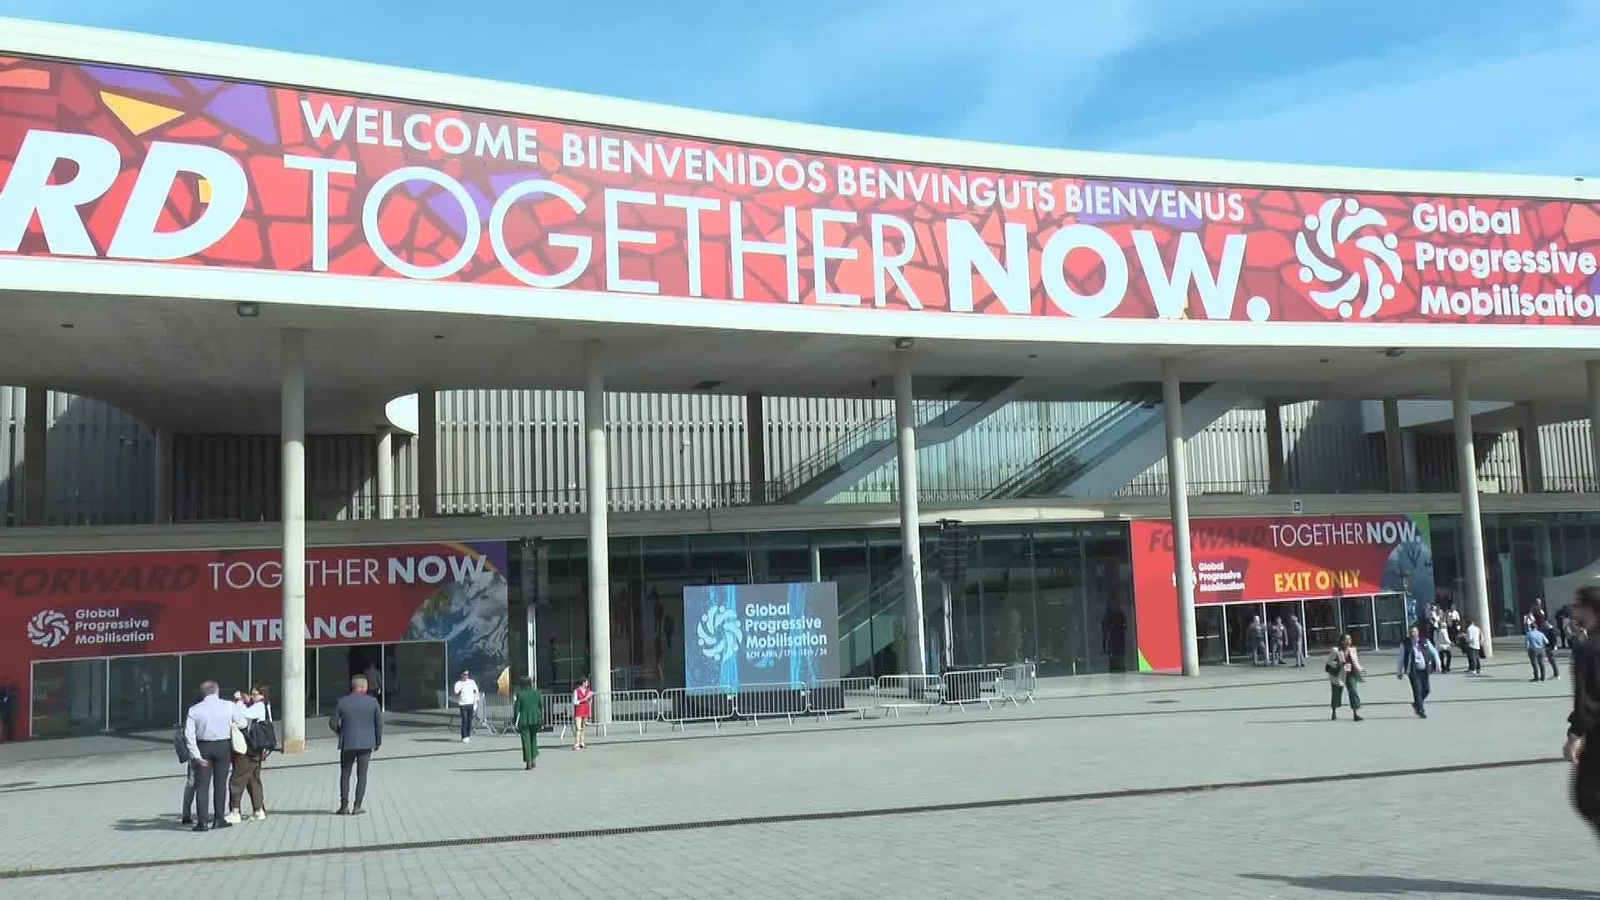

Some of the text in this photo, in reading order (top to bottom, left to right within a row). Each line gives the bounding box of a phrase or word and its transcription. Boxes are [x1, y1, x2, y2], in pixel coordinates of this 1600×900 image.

[300, 99, 1246, 222] WELCOME BIENVENIDOS BENVINGUTS BIENVENUS
[1412, 203, 1521, 235] Global
[283, 153, 925, 310] TOGETHER
[946, 217, 1271, 321] NOW.
[1415, 242, 1598, 279] Progressive
[1269, 522, 1364, 547] TOGETHER
[1366, 521, 1421, 544] NOW.
[207, 556, 380, 591] TOGTHER
[1198, 562, 1225, 572] Global
[1198, 570, 1242, 582] Progressive
[1274, 569, 1361, 593] EXIT ONLY
[75, 607, 120, 619] Global
[745, 603, 790, 617] Global
[75, 618, 150, 632] Progressive
[209, 615, 374, 645] ENTRNCE
[745, 615, 822, 634] Progressive
[75, 631, 155, 645] Mobilisation
[746, 631, 828, 649] Mobilisation
